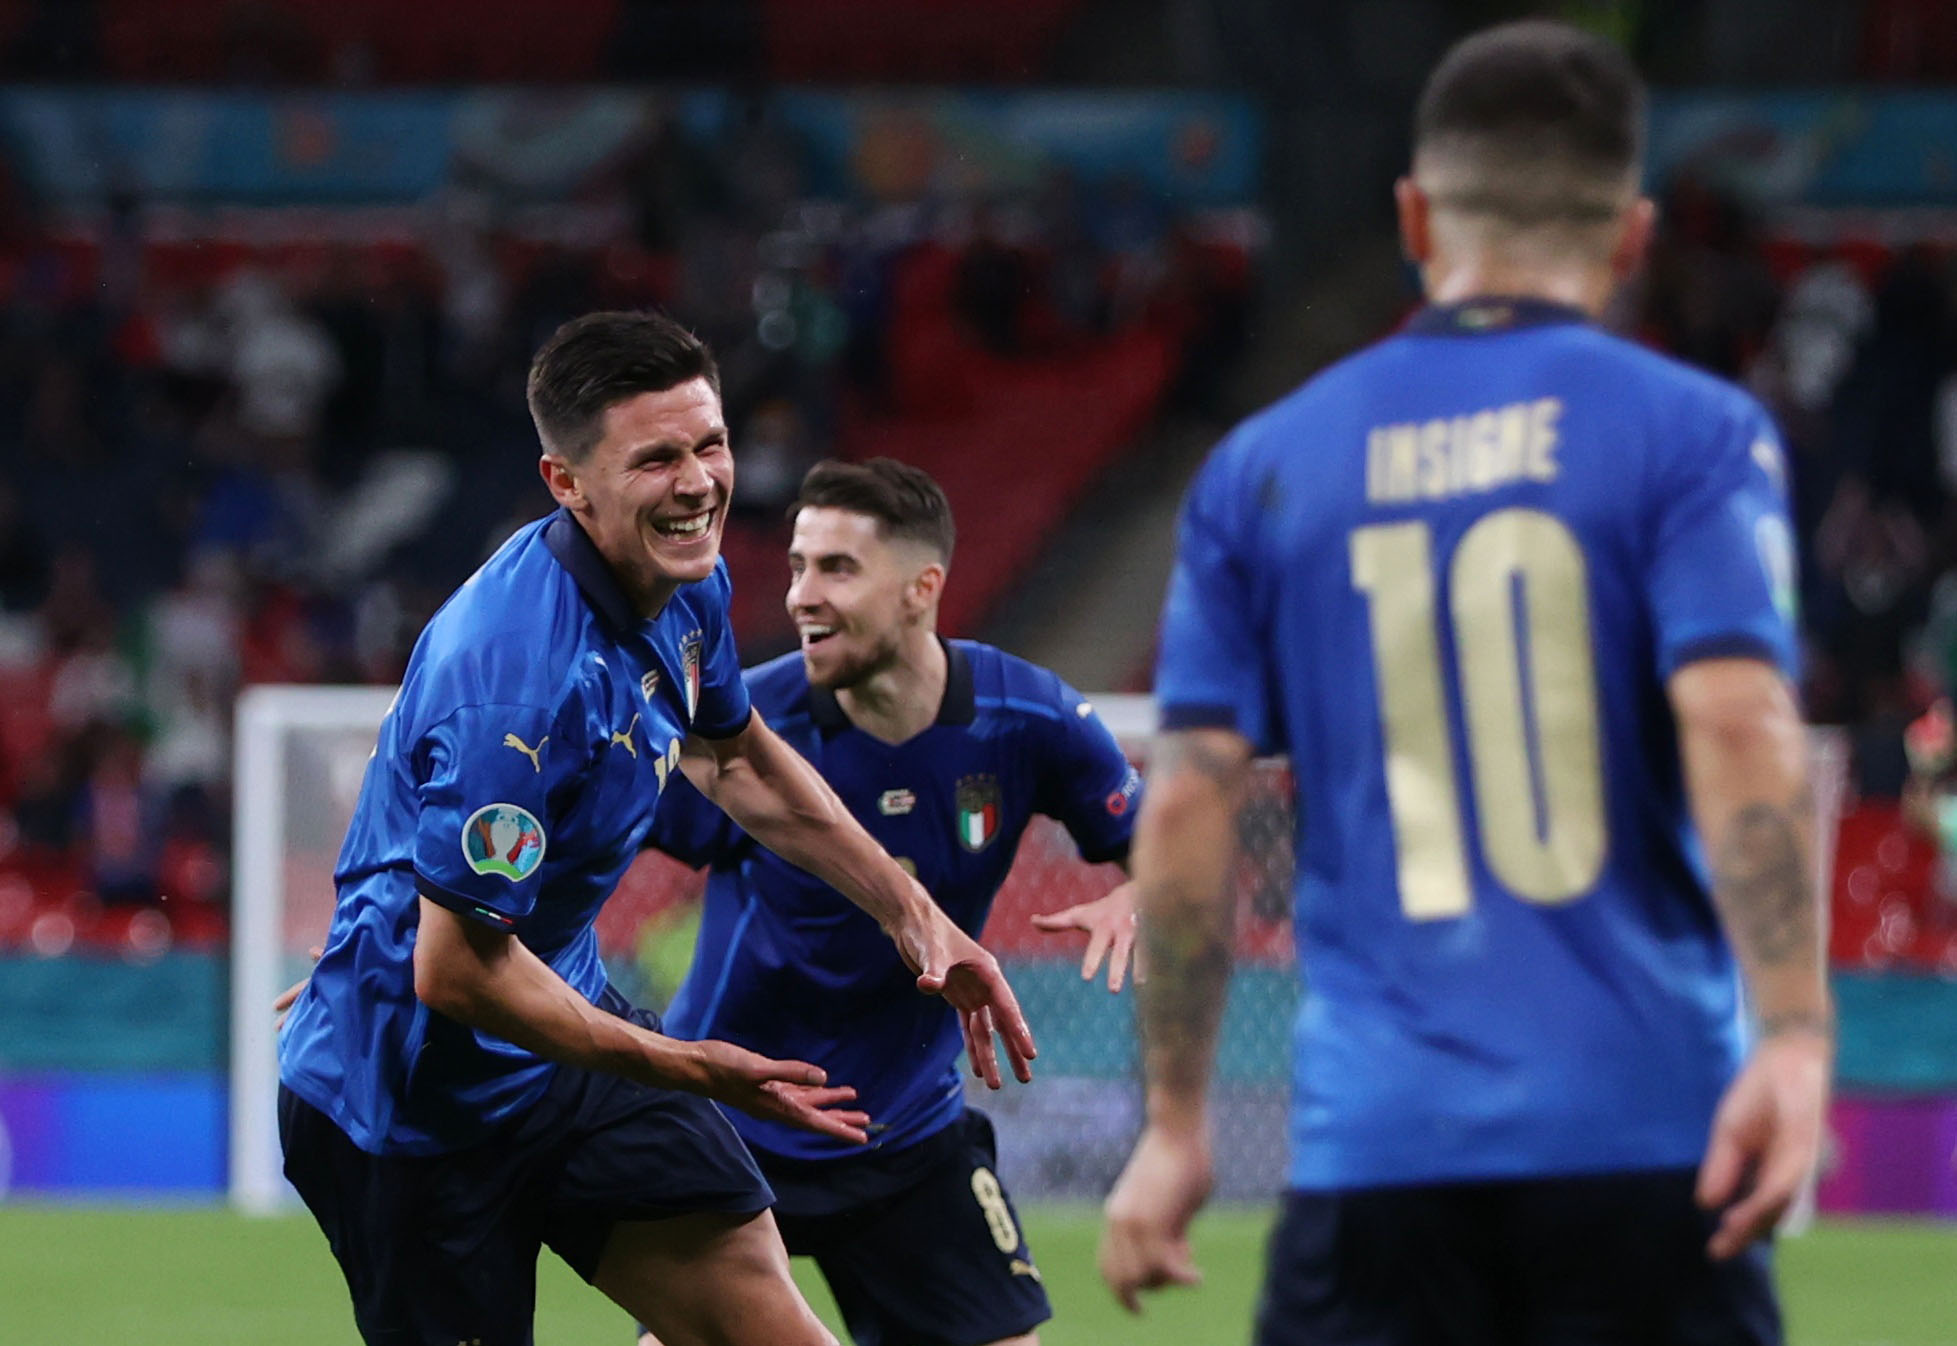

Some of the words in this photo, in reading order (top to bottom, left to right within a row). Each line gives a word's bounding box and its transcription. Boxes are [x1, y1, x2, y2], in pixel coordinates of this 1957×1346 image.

[1365, 397, 1562, 504] INSIGNE
[1350, 507, 1607, 921] 10
[971, 1166, 1019, 1254] 8
